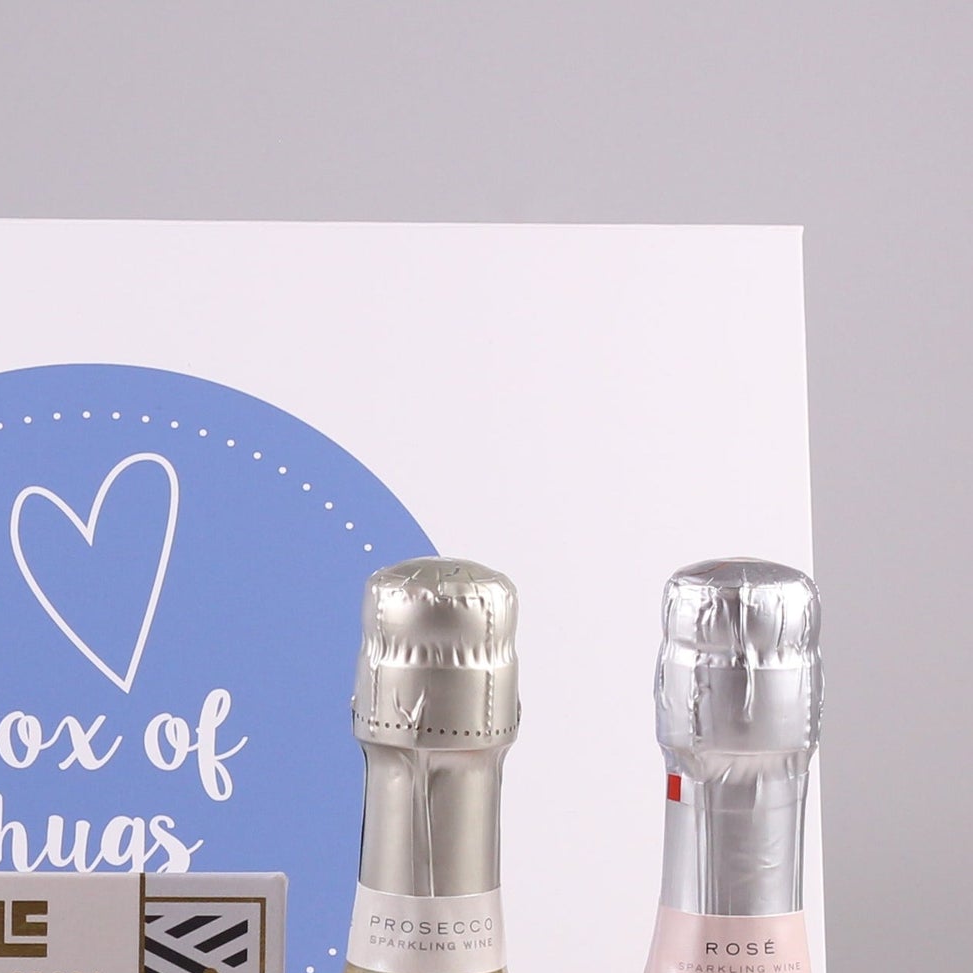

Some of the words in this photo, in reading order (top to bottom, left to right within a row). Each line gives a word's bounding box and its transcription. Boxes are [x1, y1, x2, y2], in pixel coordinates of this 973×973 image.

[144, 688, 248, 801] of
[369, 915, 493, 935] PROSECCO
[369, 935, 456, 951] SPARKLING
[463, 937, 493, 950] WINE
[705, 939, 775, 956] ROSÉ
[678, 961, 766, 973] SPARKLING
[773, 962, 801, 972] WINE
